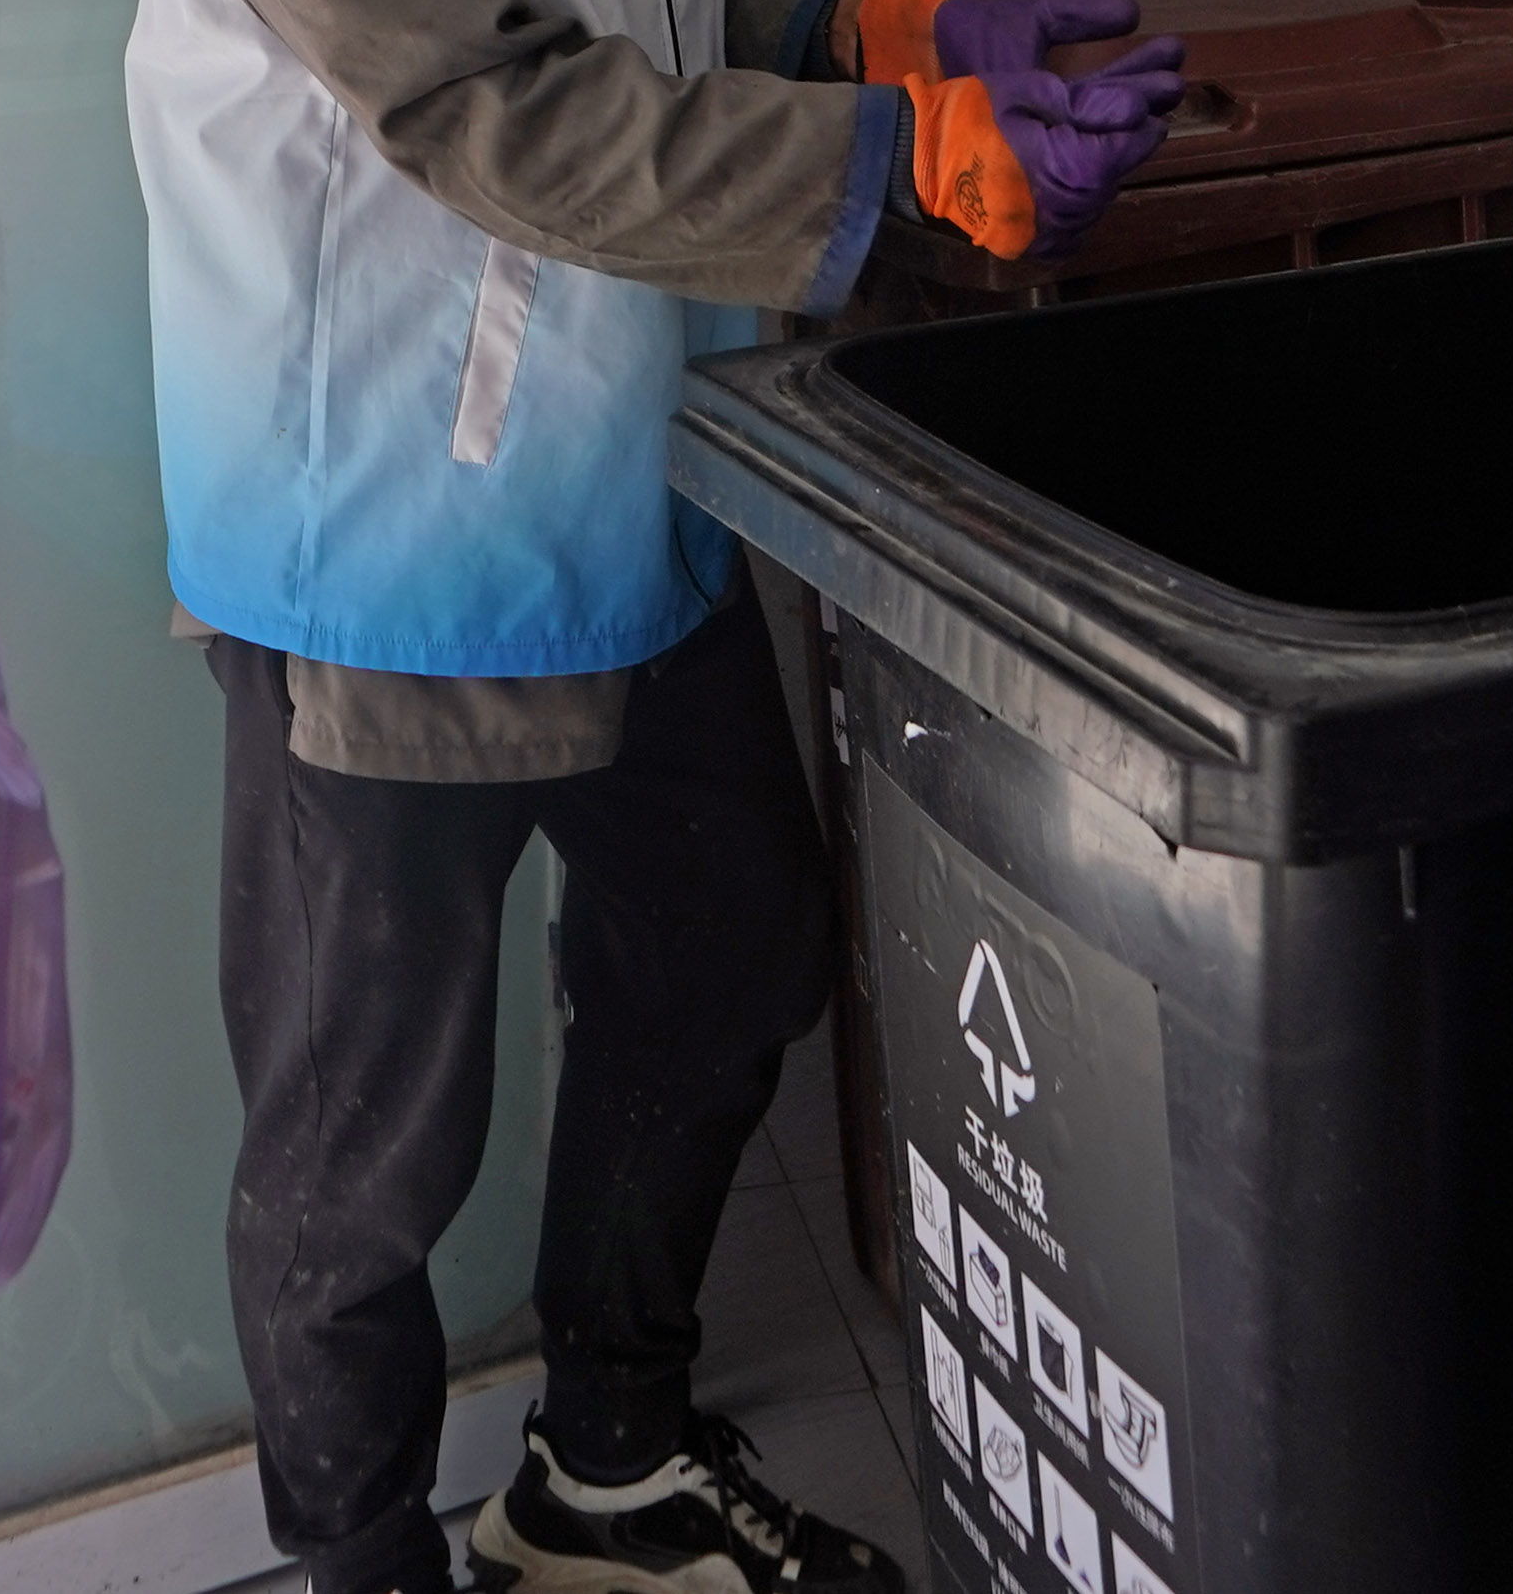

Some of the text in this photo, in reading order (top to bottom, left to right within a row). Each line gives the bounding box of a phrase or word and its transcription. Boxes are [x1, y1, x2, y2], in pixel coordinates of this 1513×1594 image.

[957, 1142, 1068, 1273] RESIDUAL WASTE
[965, 1105, 1048, 1224] 干垃圾
